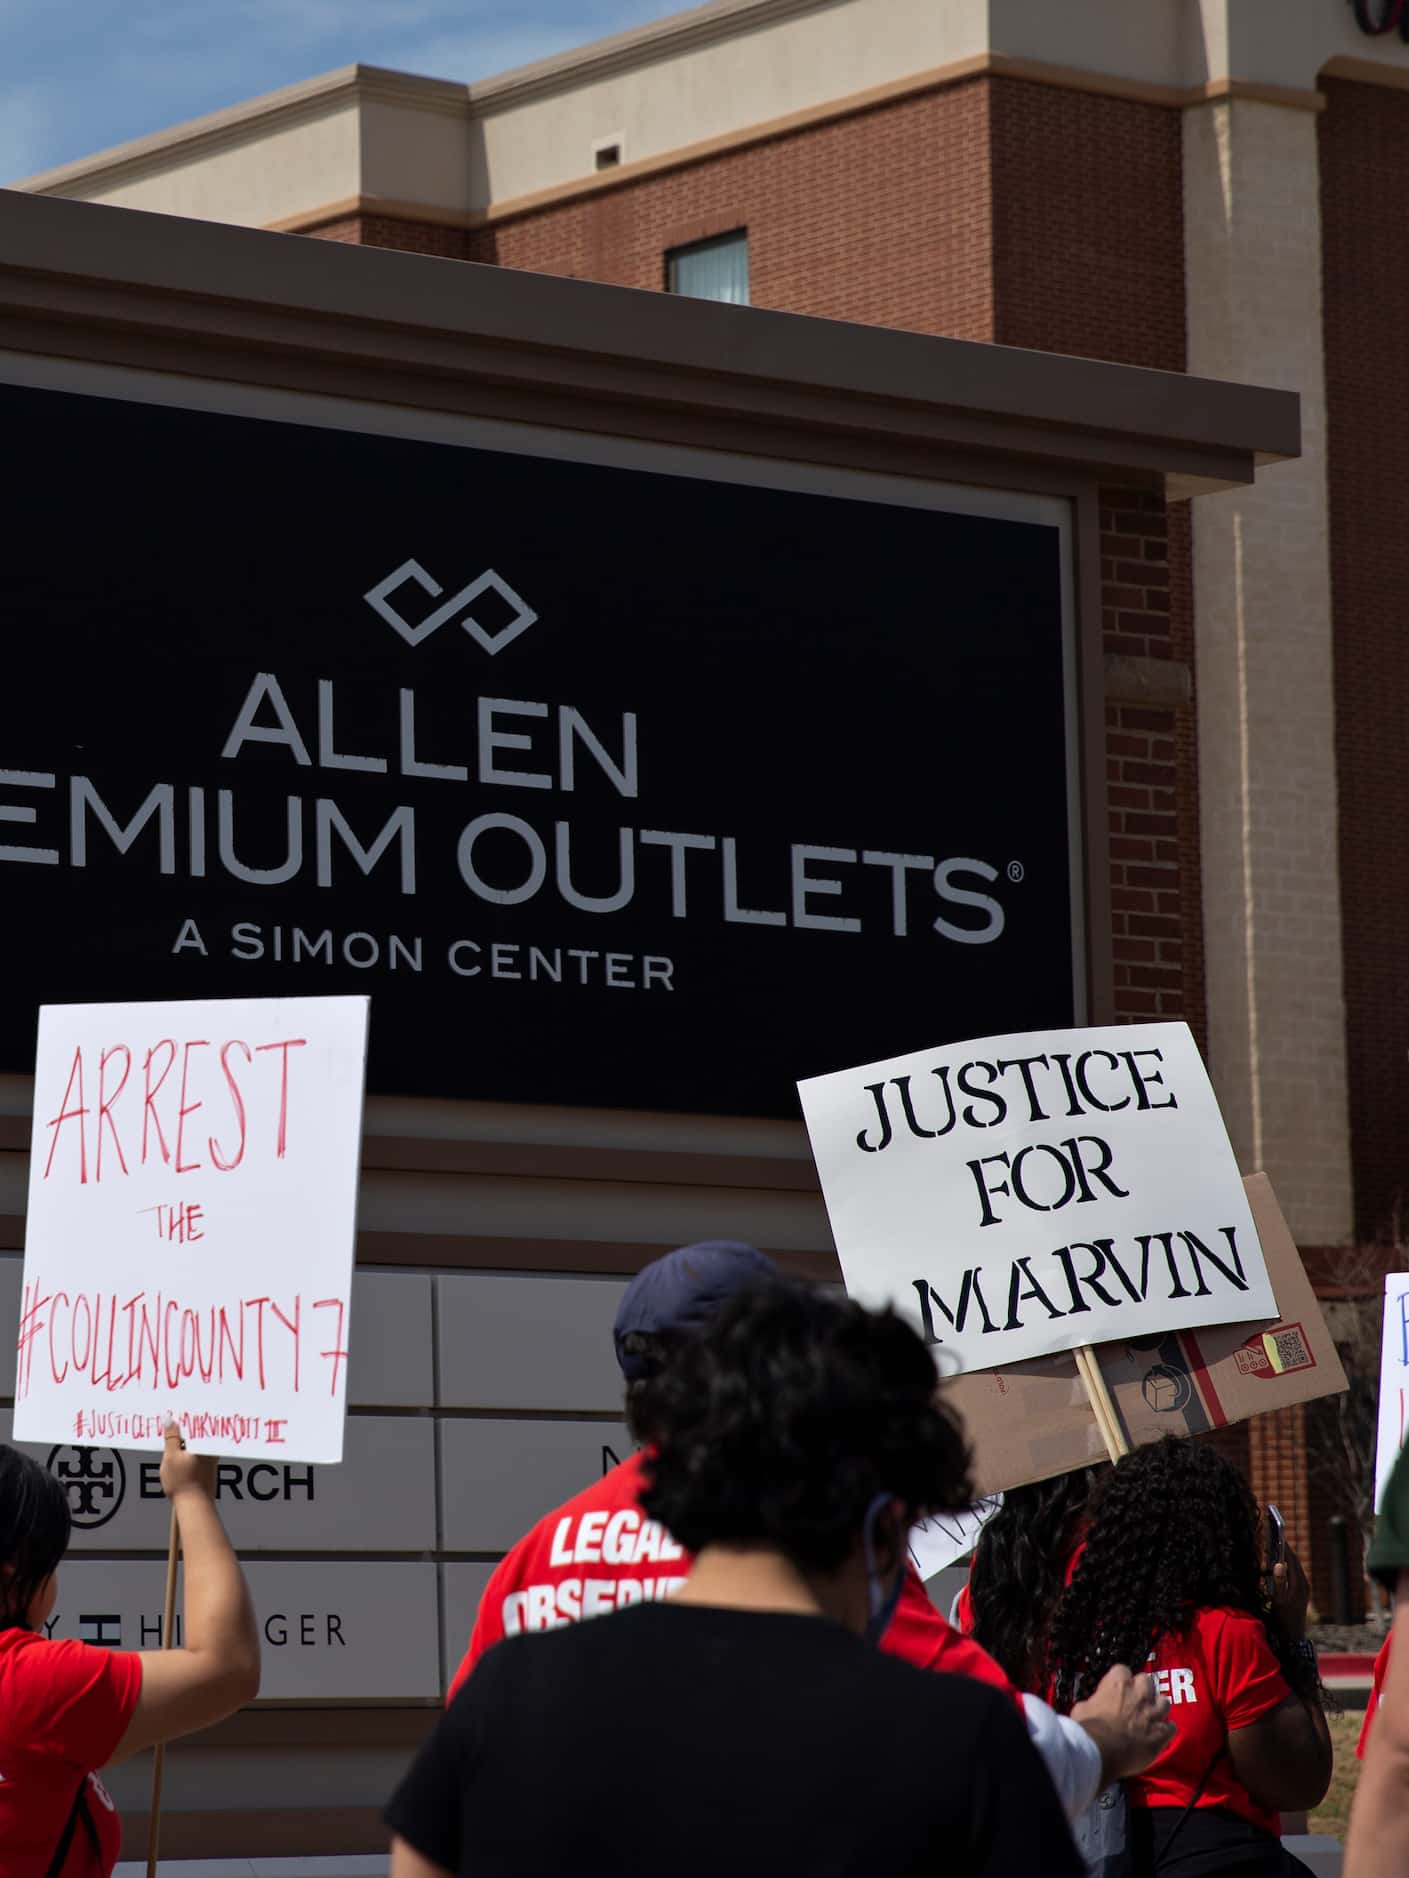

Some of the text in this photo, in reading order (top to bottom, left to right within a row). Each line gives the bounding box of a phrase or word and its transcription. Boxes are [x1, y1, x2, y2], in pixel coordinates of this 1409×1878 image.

[221, 672, 638, 798] ALLEN
[172, 919, 675, 991] A SIMON CENTER
[44, 1038, 308, 1184] ARREST
[856, 1048, 1179, 1152] JUSTICE
[137, 1202, 205, 1244] THE
[966, 1135, 1130, 1227] FOR
[911, 1226, 1250, 1345] MARVIN
[139, 1462, 315, 1501] BRCH
[142, 1614, 347, 1646] HIGER
